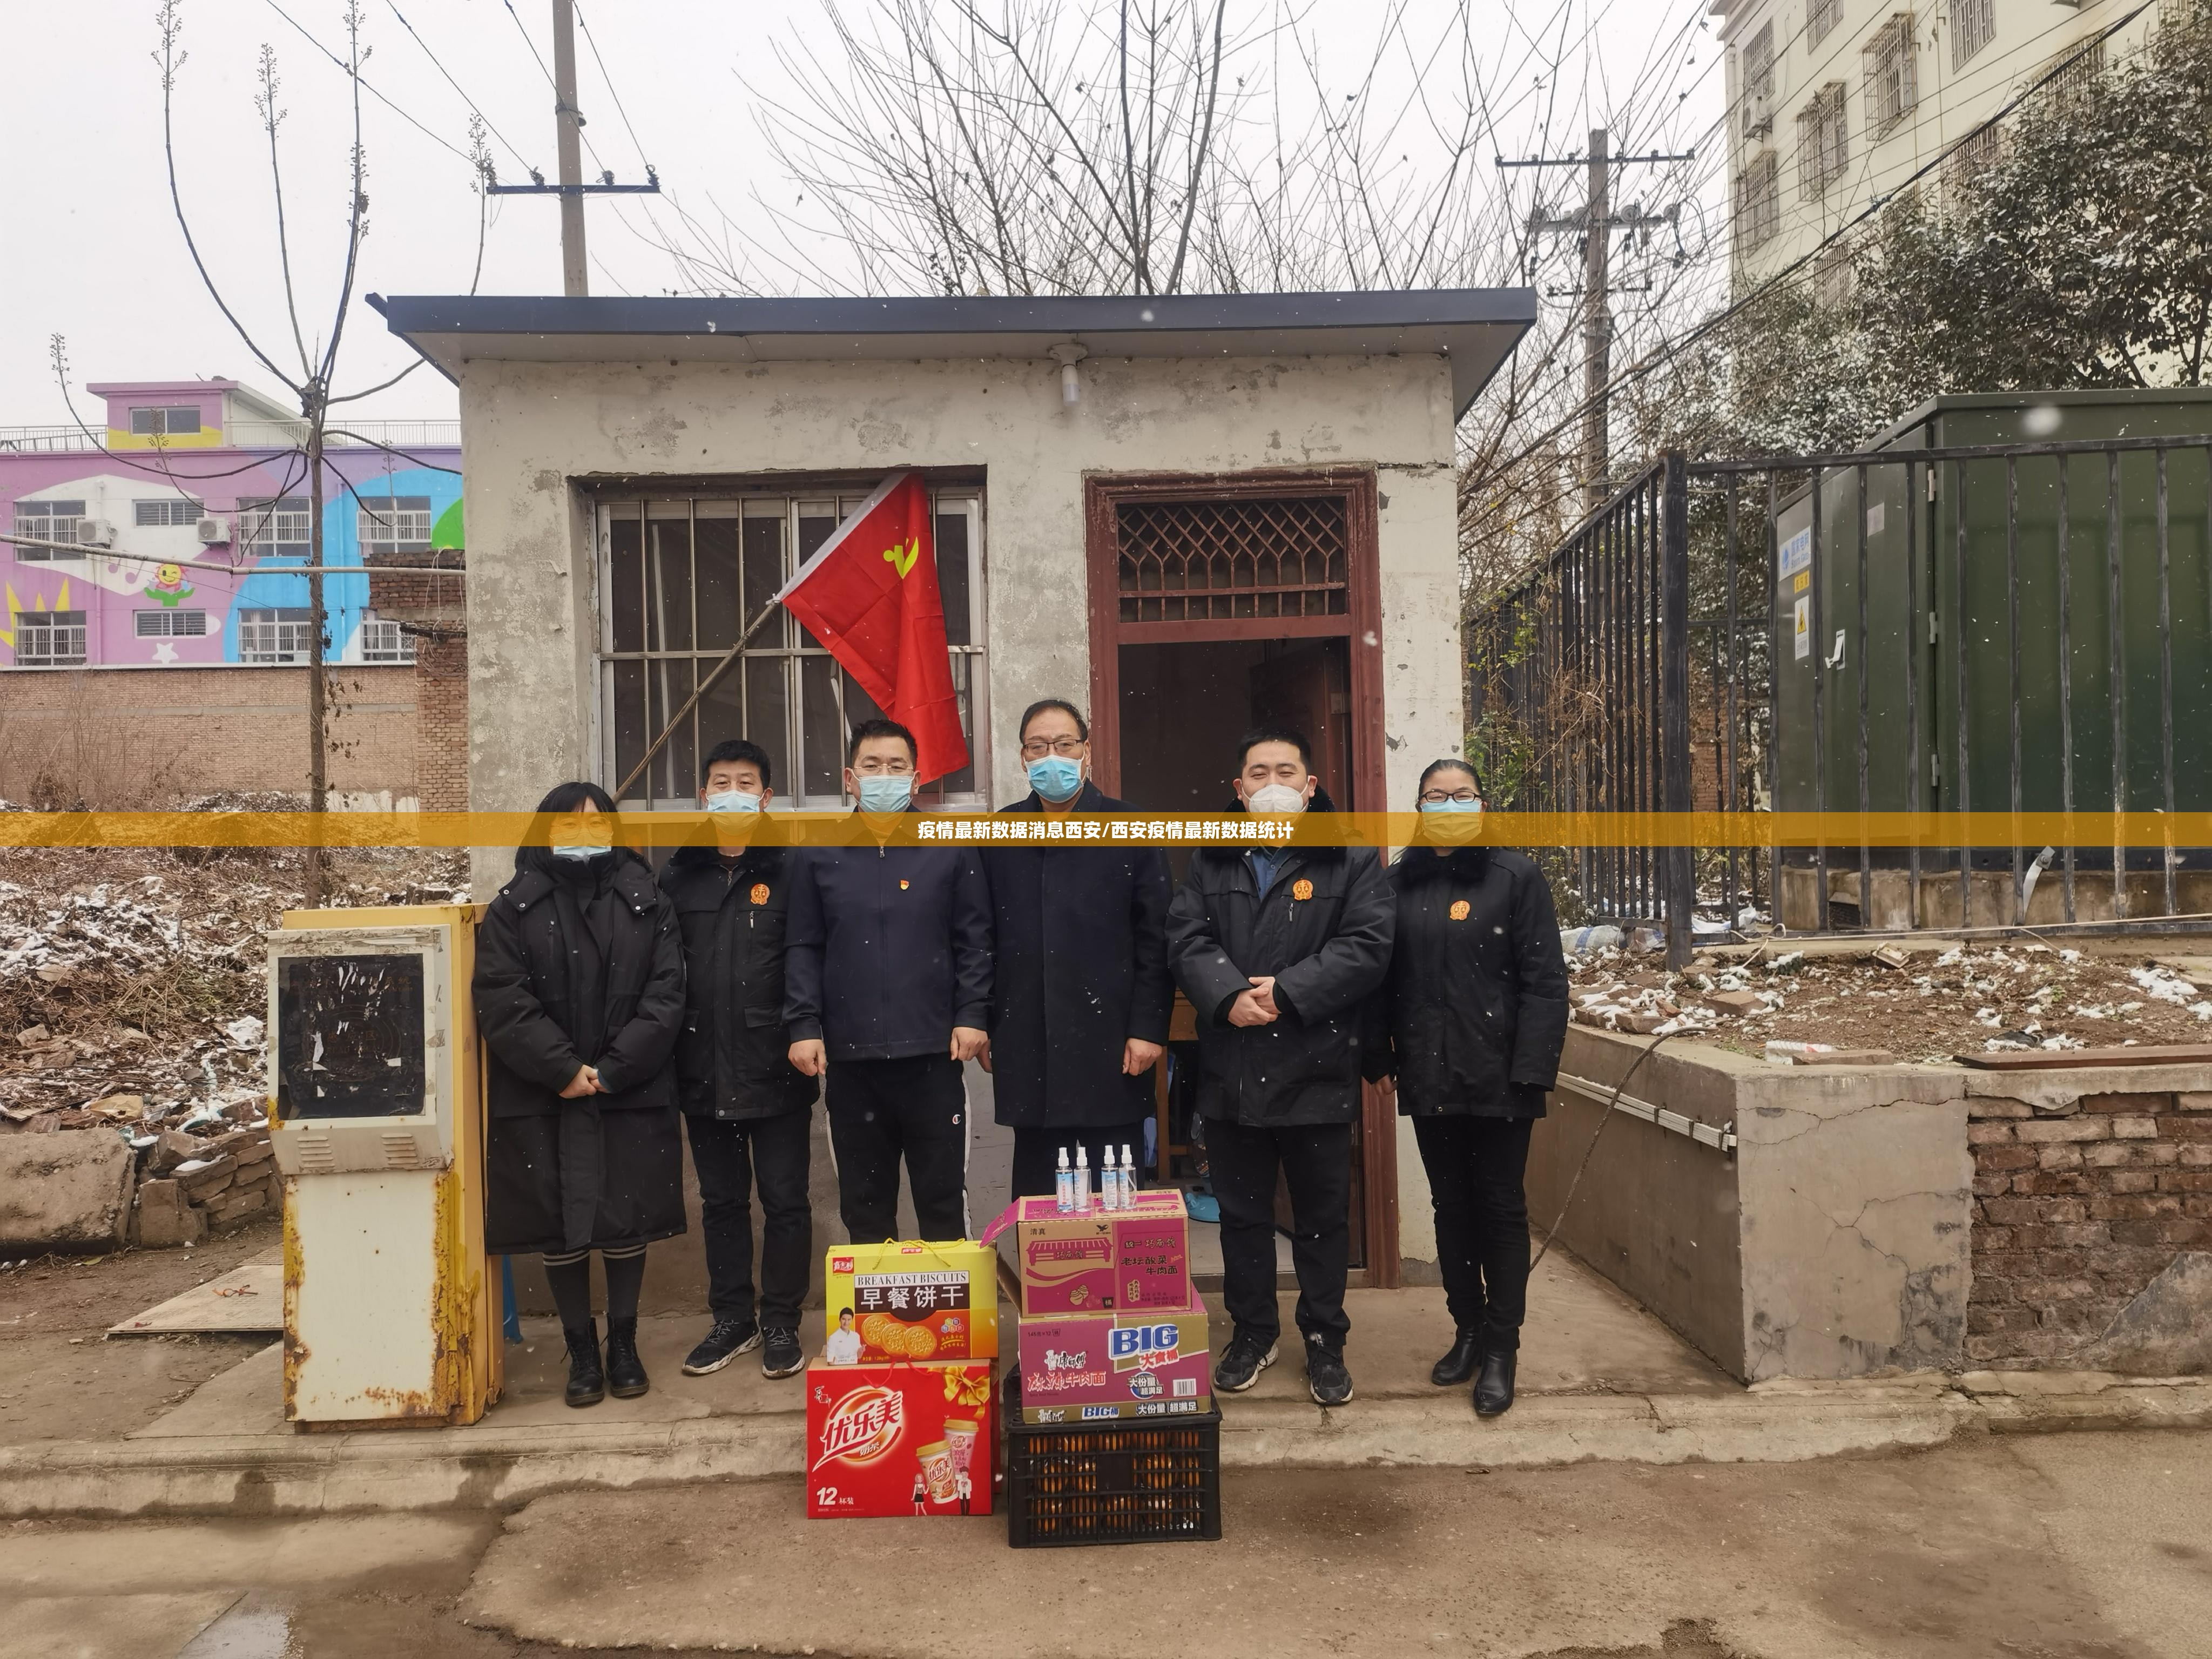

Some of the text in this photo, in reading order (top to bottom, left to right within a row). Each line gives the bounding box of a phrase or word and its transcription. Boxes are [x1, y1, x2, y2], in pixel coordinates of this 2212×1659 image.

[1030, 1228, 1046, 1236] 清真
[1121, 1255, 1167, 1266] 老坛酸菜
[1145, 1265, 1178, 1276] 牛肉面
[858, 1272, 966, 1286] BREAKFAST BISCUITS
[860, 1285, 964, 1311] 早餐饼干
[1110, 1325, 1178, 1358] BIG
[1028, 1371, 1106, 1392] 麻辣牛肉面
[1129, 1377, 1156, 1387] 大份量
[1138, 1401, 1197, 1414] 大份量 超满足
[820, 1391, 903, 1455] 优乐美
[860, 1441, 881, 1456] 奶茶
[929, 1457, 950, 1481] 优乐美
[816, 1487, 854, 1505] 12 杯装
